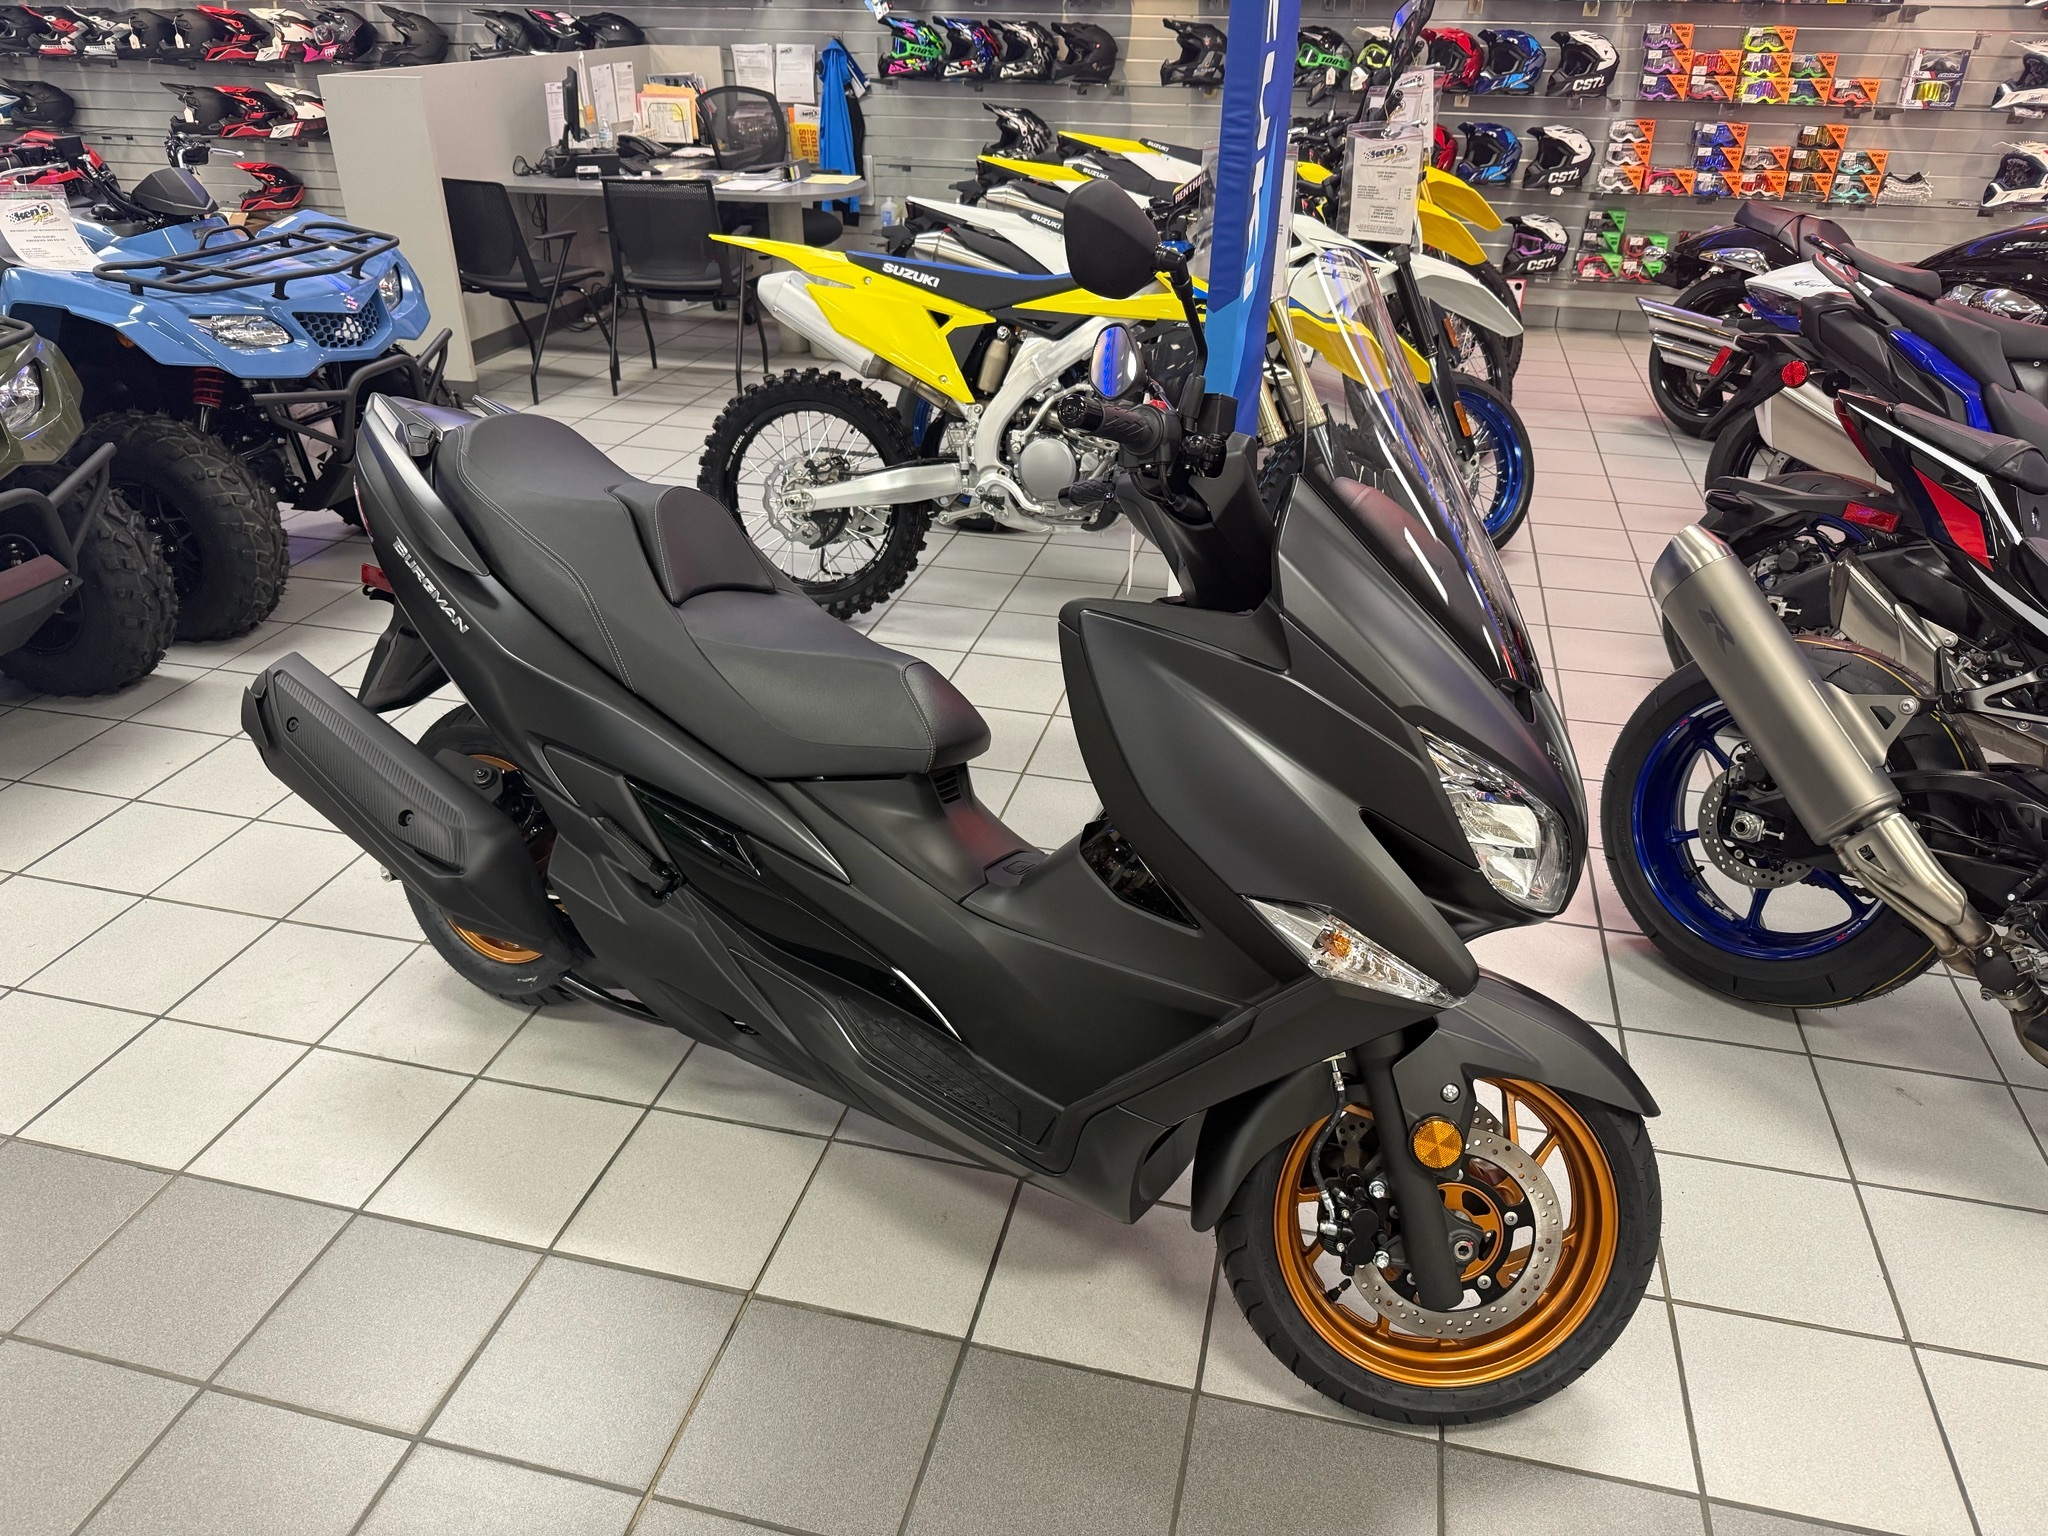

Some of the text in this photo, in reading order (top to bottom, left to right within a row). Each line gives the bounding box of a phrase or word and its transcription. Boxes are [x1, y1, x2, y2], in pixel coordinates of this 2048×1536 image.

[910, 44, 934, 56] 100%
[1321, 56, 1345, 68] 100%
[1146, 140, 1170, 152] SUZUKI
[1082, 167, 1110, 180] SUZUKI
[1174, 172, 1209, 205] RENTHAL
[1031, 213, 1062, 230] SUZUKI
[881, 262, 941, 288] SUZUKI
[392, 535, 470, 634] BURGMAN
